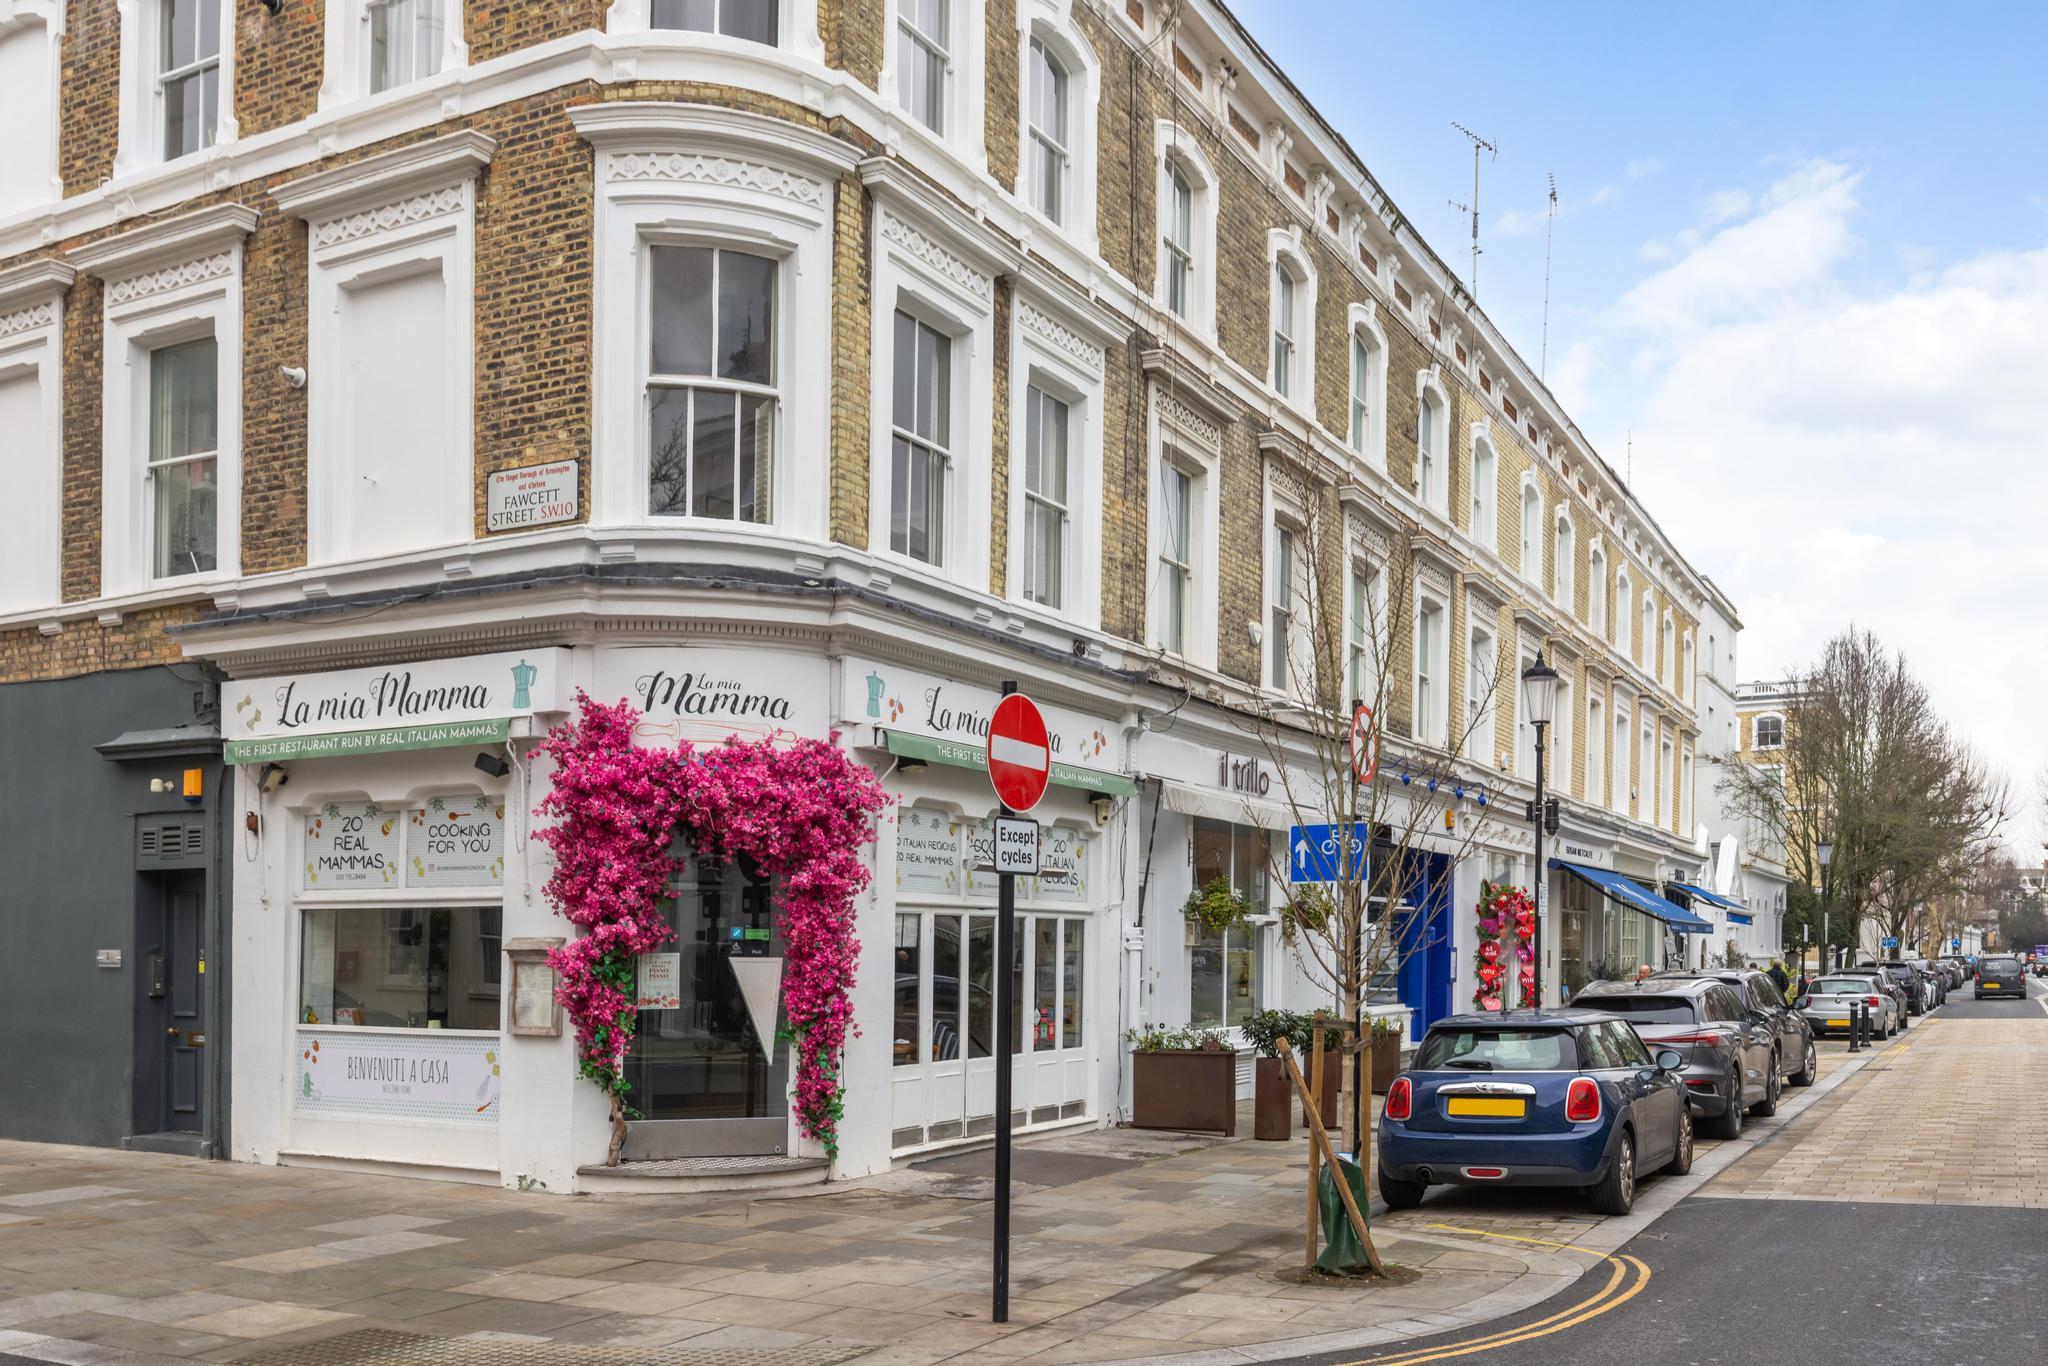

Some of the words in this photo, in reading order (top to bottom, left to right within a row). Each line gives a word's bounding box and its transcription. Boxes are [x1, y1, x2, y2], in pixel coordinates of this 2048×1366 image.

[519, 470, 537, 480] Borough
[545, 465, 570, 476] Kensington
[504, 488, 560, 510] FAWCETT
[695, 673, 713, 690] La
[717, 679, 742, 691] mia
[276, 681, 314, 728] La
[317, 690, 366, 720] mia
[369, 672, 492, 717] Mamma
[635, 671, 795, 720] Mamma
[925, 686, 955, 731] La
[956, 709, 990, 738] mia
[234, 746, 251, 757] THE
[254, 743, 278, 755] FIRST
[280, 738, 339, 753] RESTAURANT
[341, 736, 363, 748] RUN
[365, 734, 377, 746] BY
[380, 732, 404, 745] REAL
[407, 728, 447, 742] ITALIAN
[449, 723, 498, 738] MAMMAS
[938, 745, 952, 757] THE
[953, 748, 971, 760] FIRST
[1055, 768, 1077, 781] ITALIAN
[1078, 773, 1103, 786] MAMMAS
[1220, 751, 1229, 787] il
[1232, 757, 1270, 795] trillo
[342, 816, 363, 832] 20
[428, 823, 490, 838] COOKING
[334, 836, 369, 851] REAL
[903, 837, 926, 849] ITALIAN
[928, 840, 957, 852] REGIONS
[1000, 827, 1034, 847] Except
[428, 840, 456, 854] FOR
[461, 839, 491, 853] YOU
[1054, 839, 1067, 853] 20
[318, 853, 385, 870] MAMMAS
[906, 853, 922, 864] REAL
[925, 855, 954, 866] MAMMAS
[1001, 848, 1032, 866] cycles
[1045, 854, 1075, 870] ITALIAN
[347, 1056, 405, 1082] BENVENUTI
[409, 1058, 417, 1082] A
[421, 1059, 449, 1084] CASA
